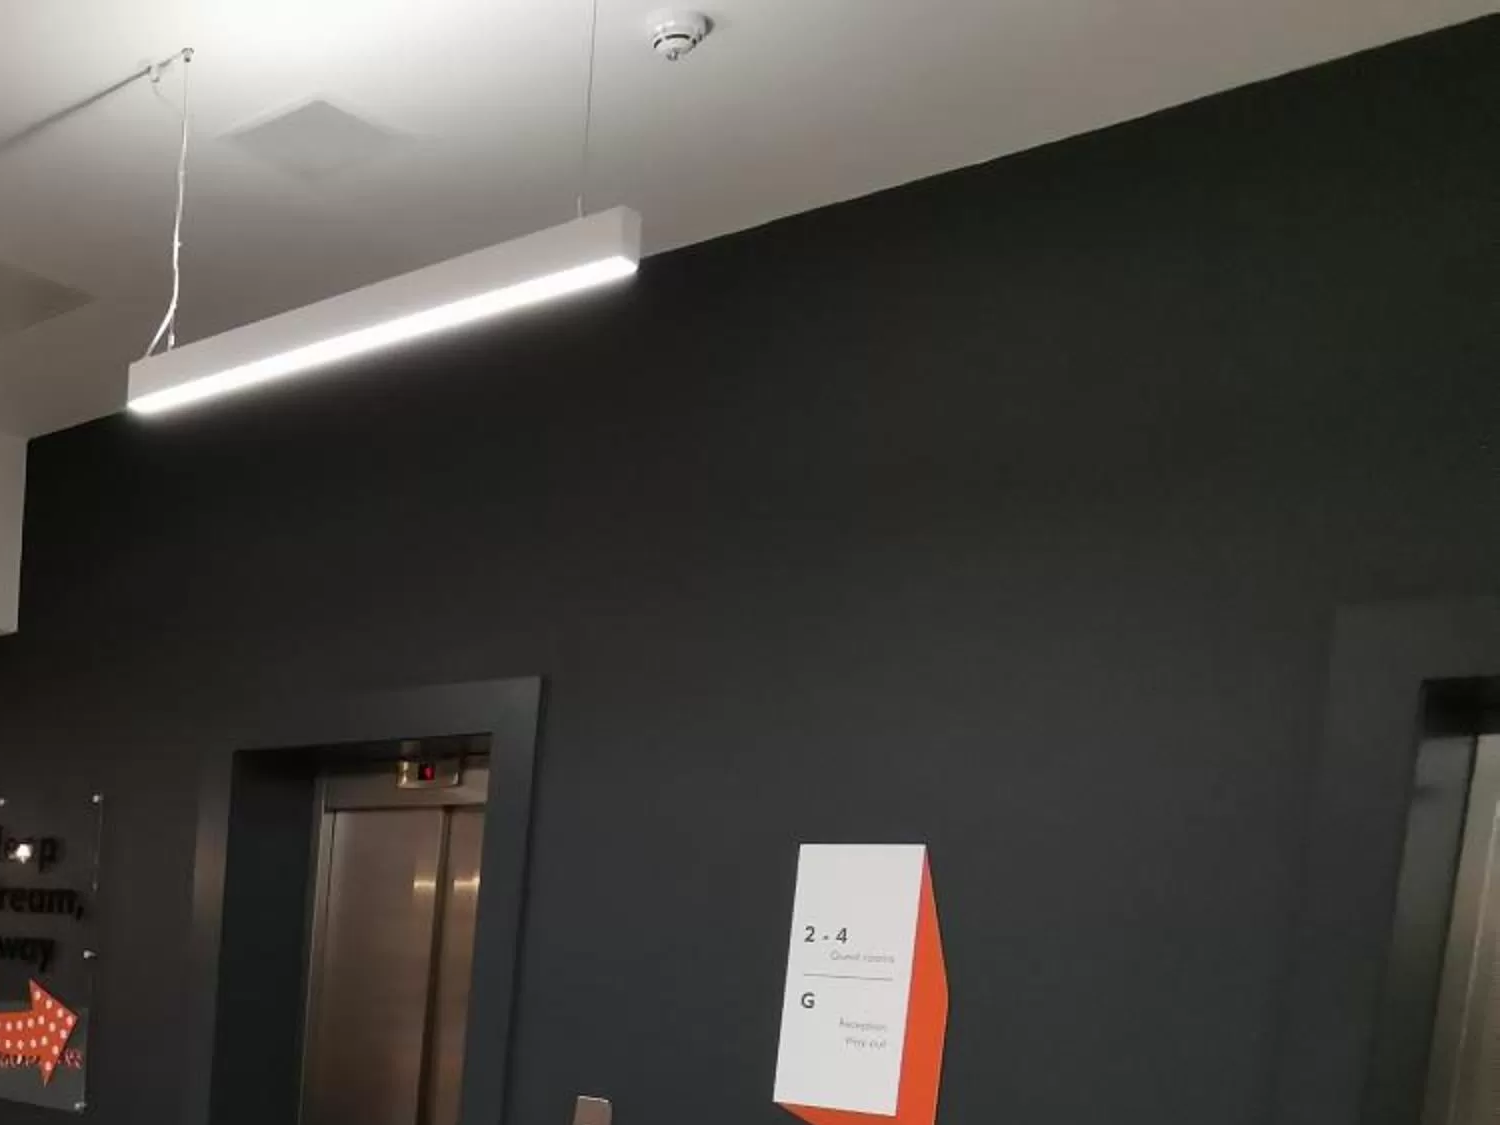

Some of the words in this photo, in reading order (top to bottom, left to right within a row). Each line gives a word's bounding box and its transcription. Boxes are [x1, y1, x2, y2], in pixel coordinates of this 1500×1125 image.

[803, 925, 816, 943] 2
[835, 927, 849, 944] 4
[800, 992, 816, 1009] G
